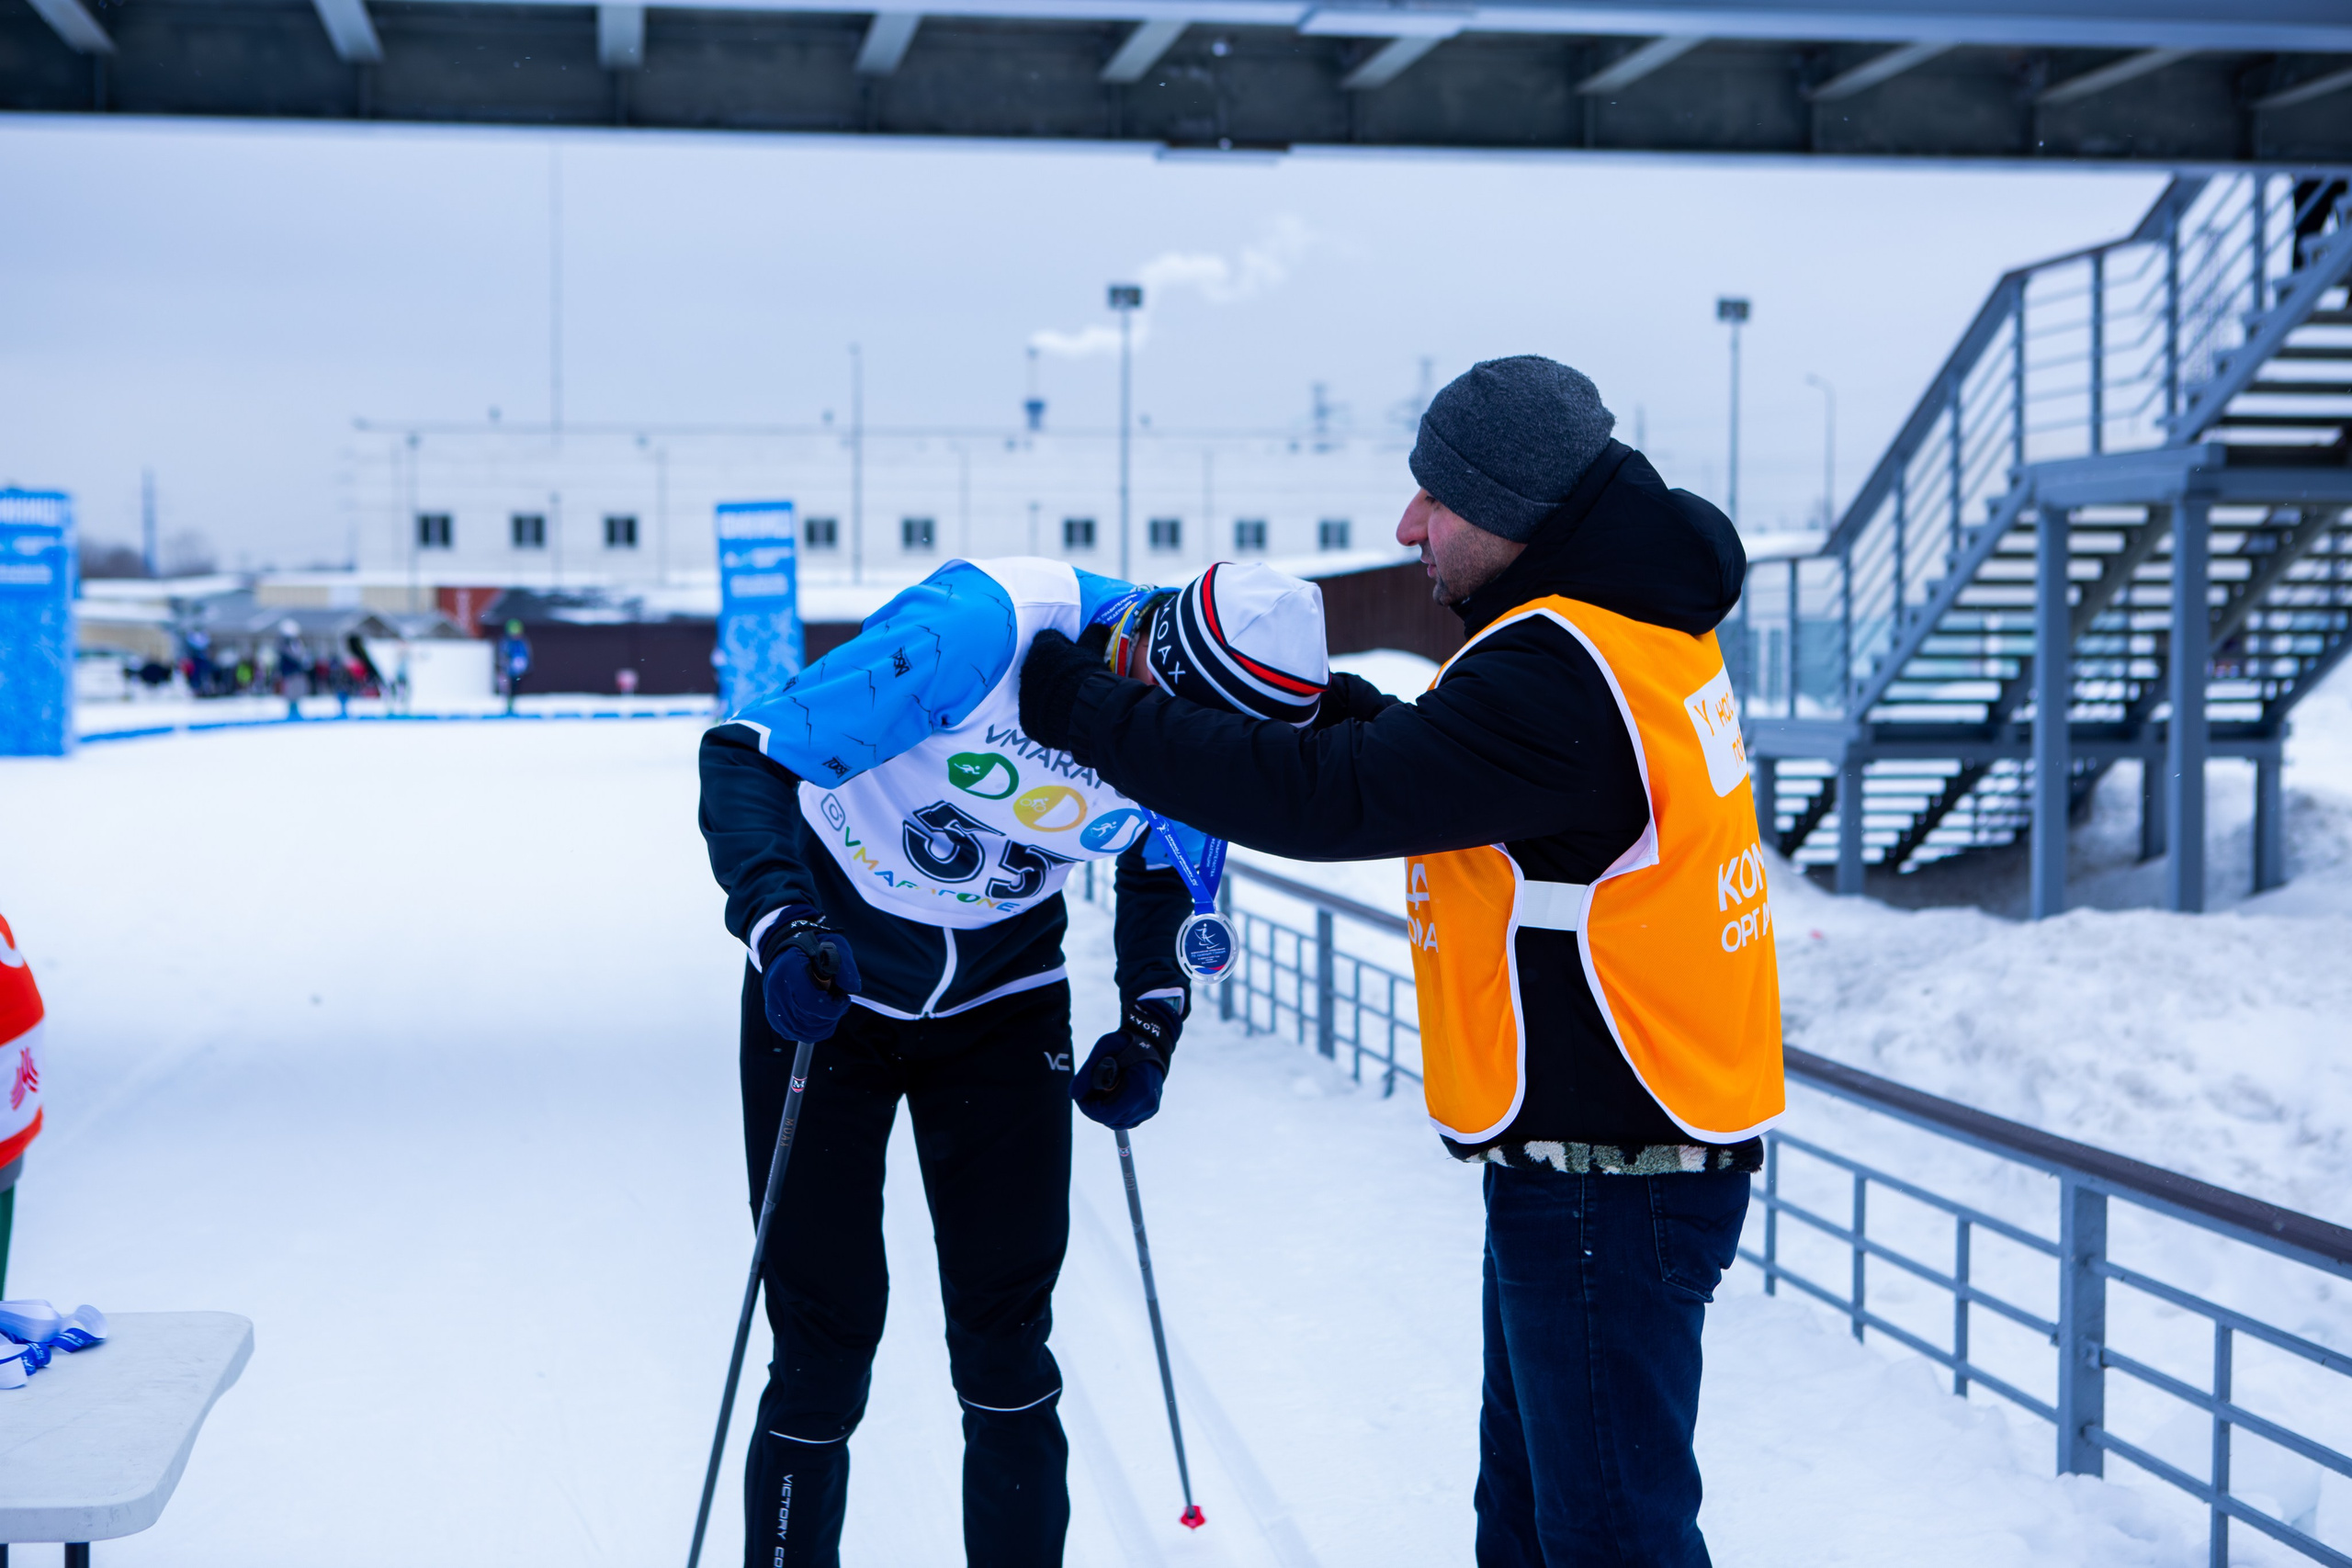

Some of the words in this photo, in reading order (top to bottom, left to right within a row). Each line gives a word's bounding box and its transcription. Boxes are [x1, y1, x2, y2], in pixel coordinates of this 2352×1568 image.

[1693, 699, 1715, 737] У
[1129, 1013, 1160, 1037] MOAX
[776, 1473, 794, 1540] VICTORY
